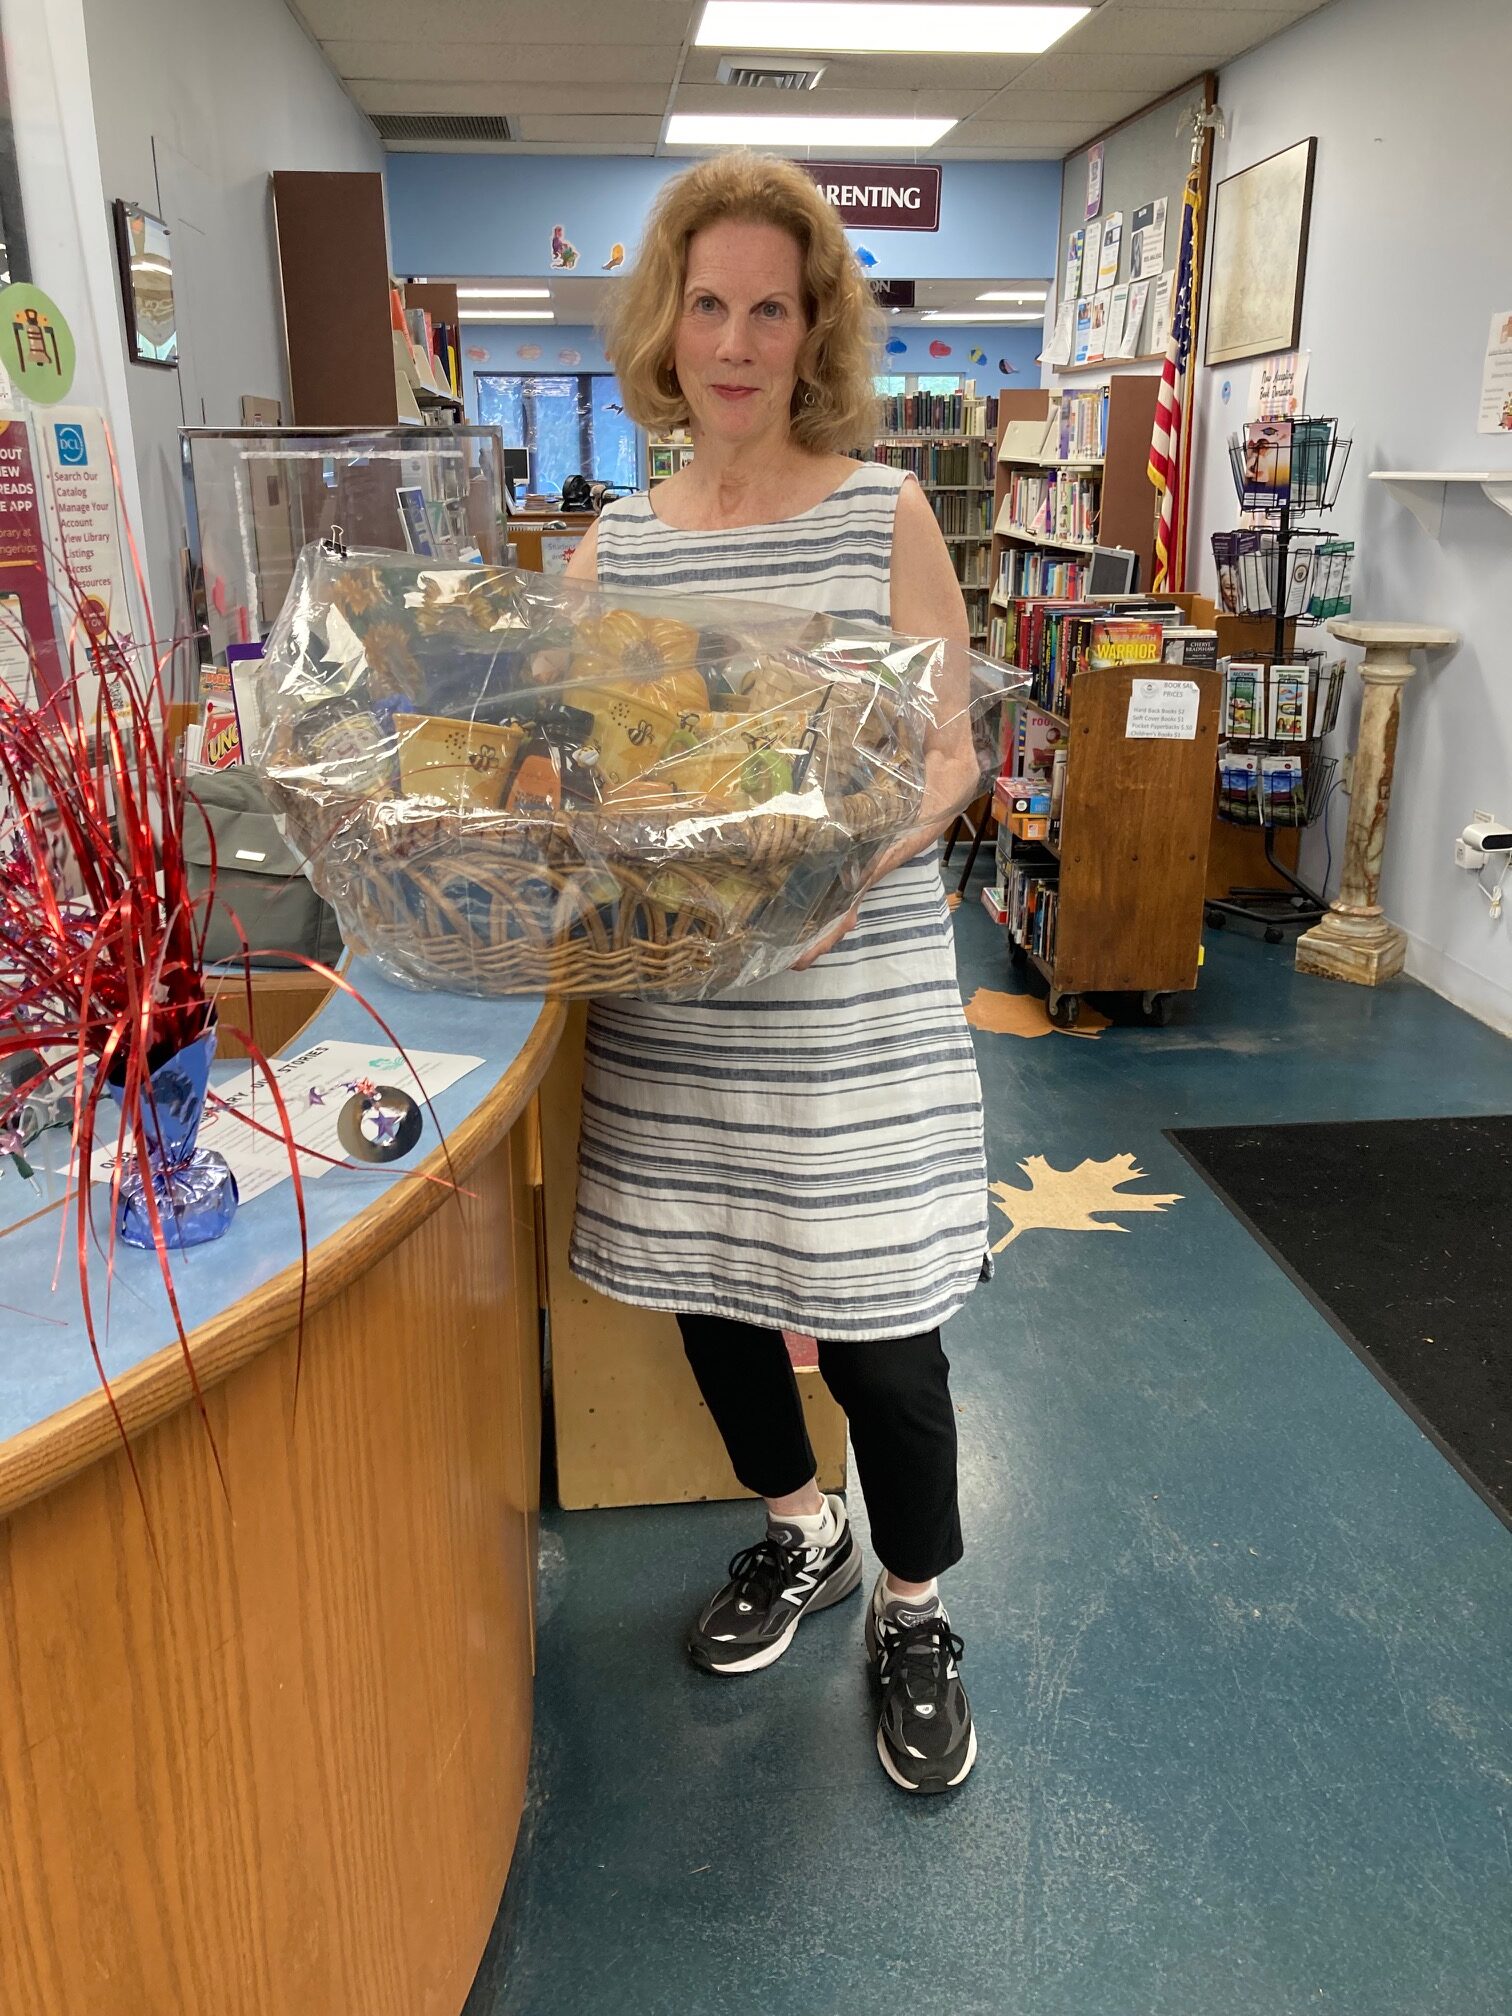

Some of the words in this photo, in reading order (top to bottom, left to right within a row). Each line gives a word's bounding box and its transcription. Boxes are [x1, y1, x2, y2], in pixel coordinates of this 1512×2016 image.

[814, 184, 921, 209] ARENTING
[60, 438, 80, 451] DCL
[54, 472, 82, 482] Search
[84, 472, 98, 481] Our
[57, 487, 87, 498] Catalog
[10, 501, 33, 512] APP
[58, 504, 90, 514] Manage
[91, 503, 109, 512] Your
[60, 519, 93, 528] Account
[63, 534, 82, 543] View
[83, 533, 110, 543] Library
[65, 549, 95, 560] Listings
[1097, 643, 1157, 660] WARRIOR
[277, 1046, 329, 1073] STORIES
